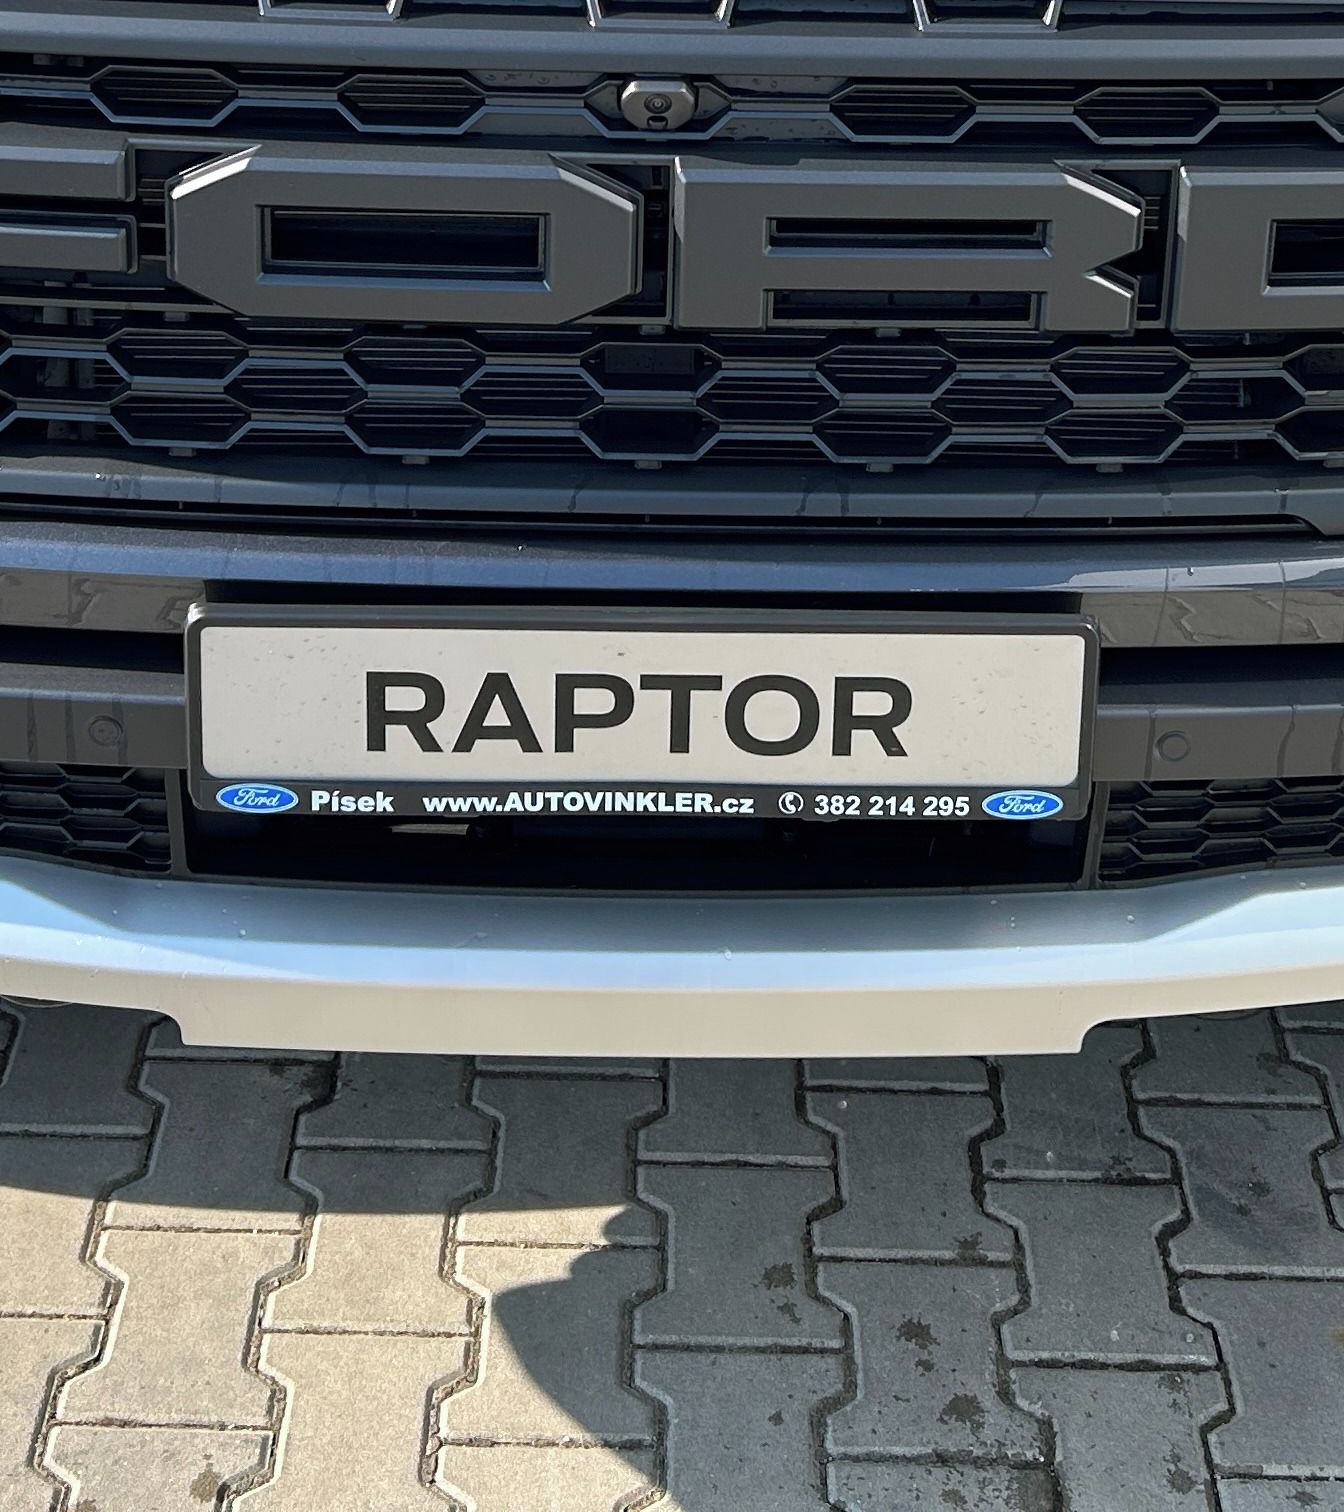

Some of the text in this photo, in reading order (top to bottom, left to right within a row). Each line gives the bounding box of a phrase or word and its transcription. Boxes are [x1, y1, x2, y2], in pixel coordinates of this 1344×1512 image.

[365, 670, 914, 757] RAPTOR
[310, 790, 971, 817] Písek www.AUTOVINKLER.cz 382 214 295
